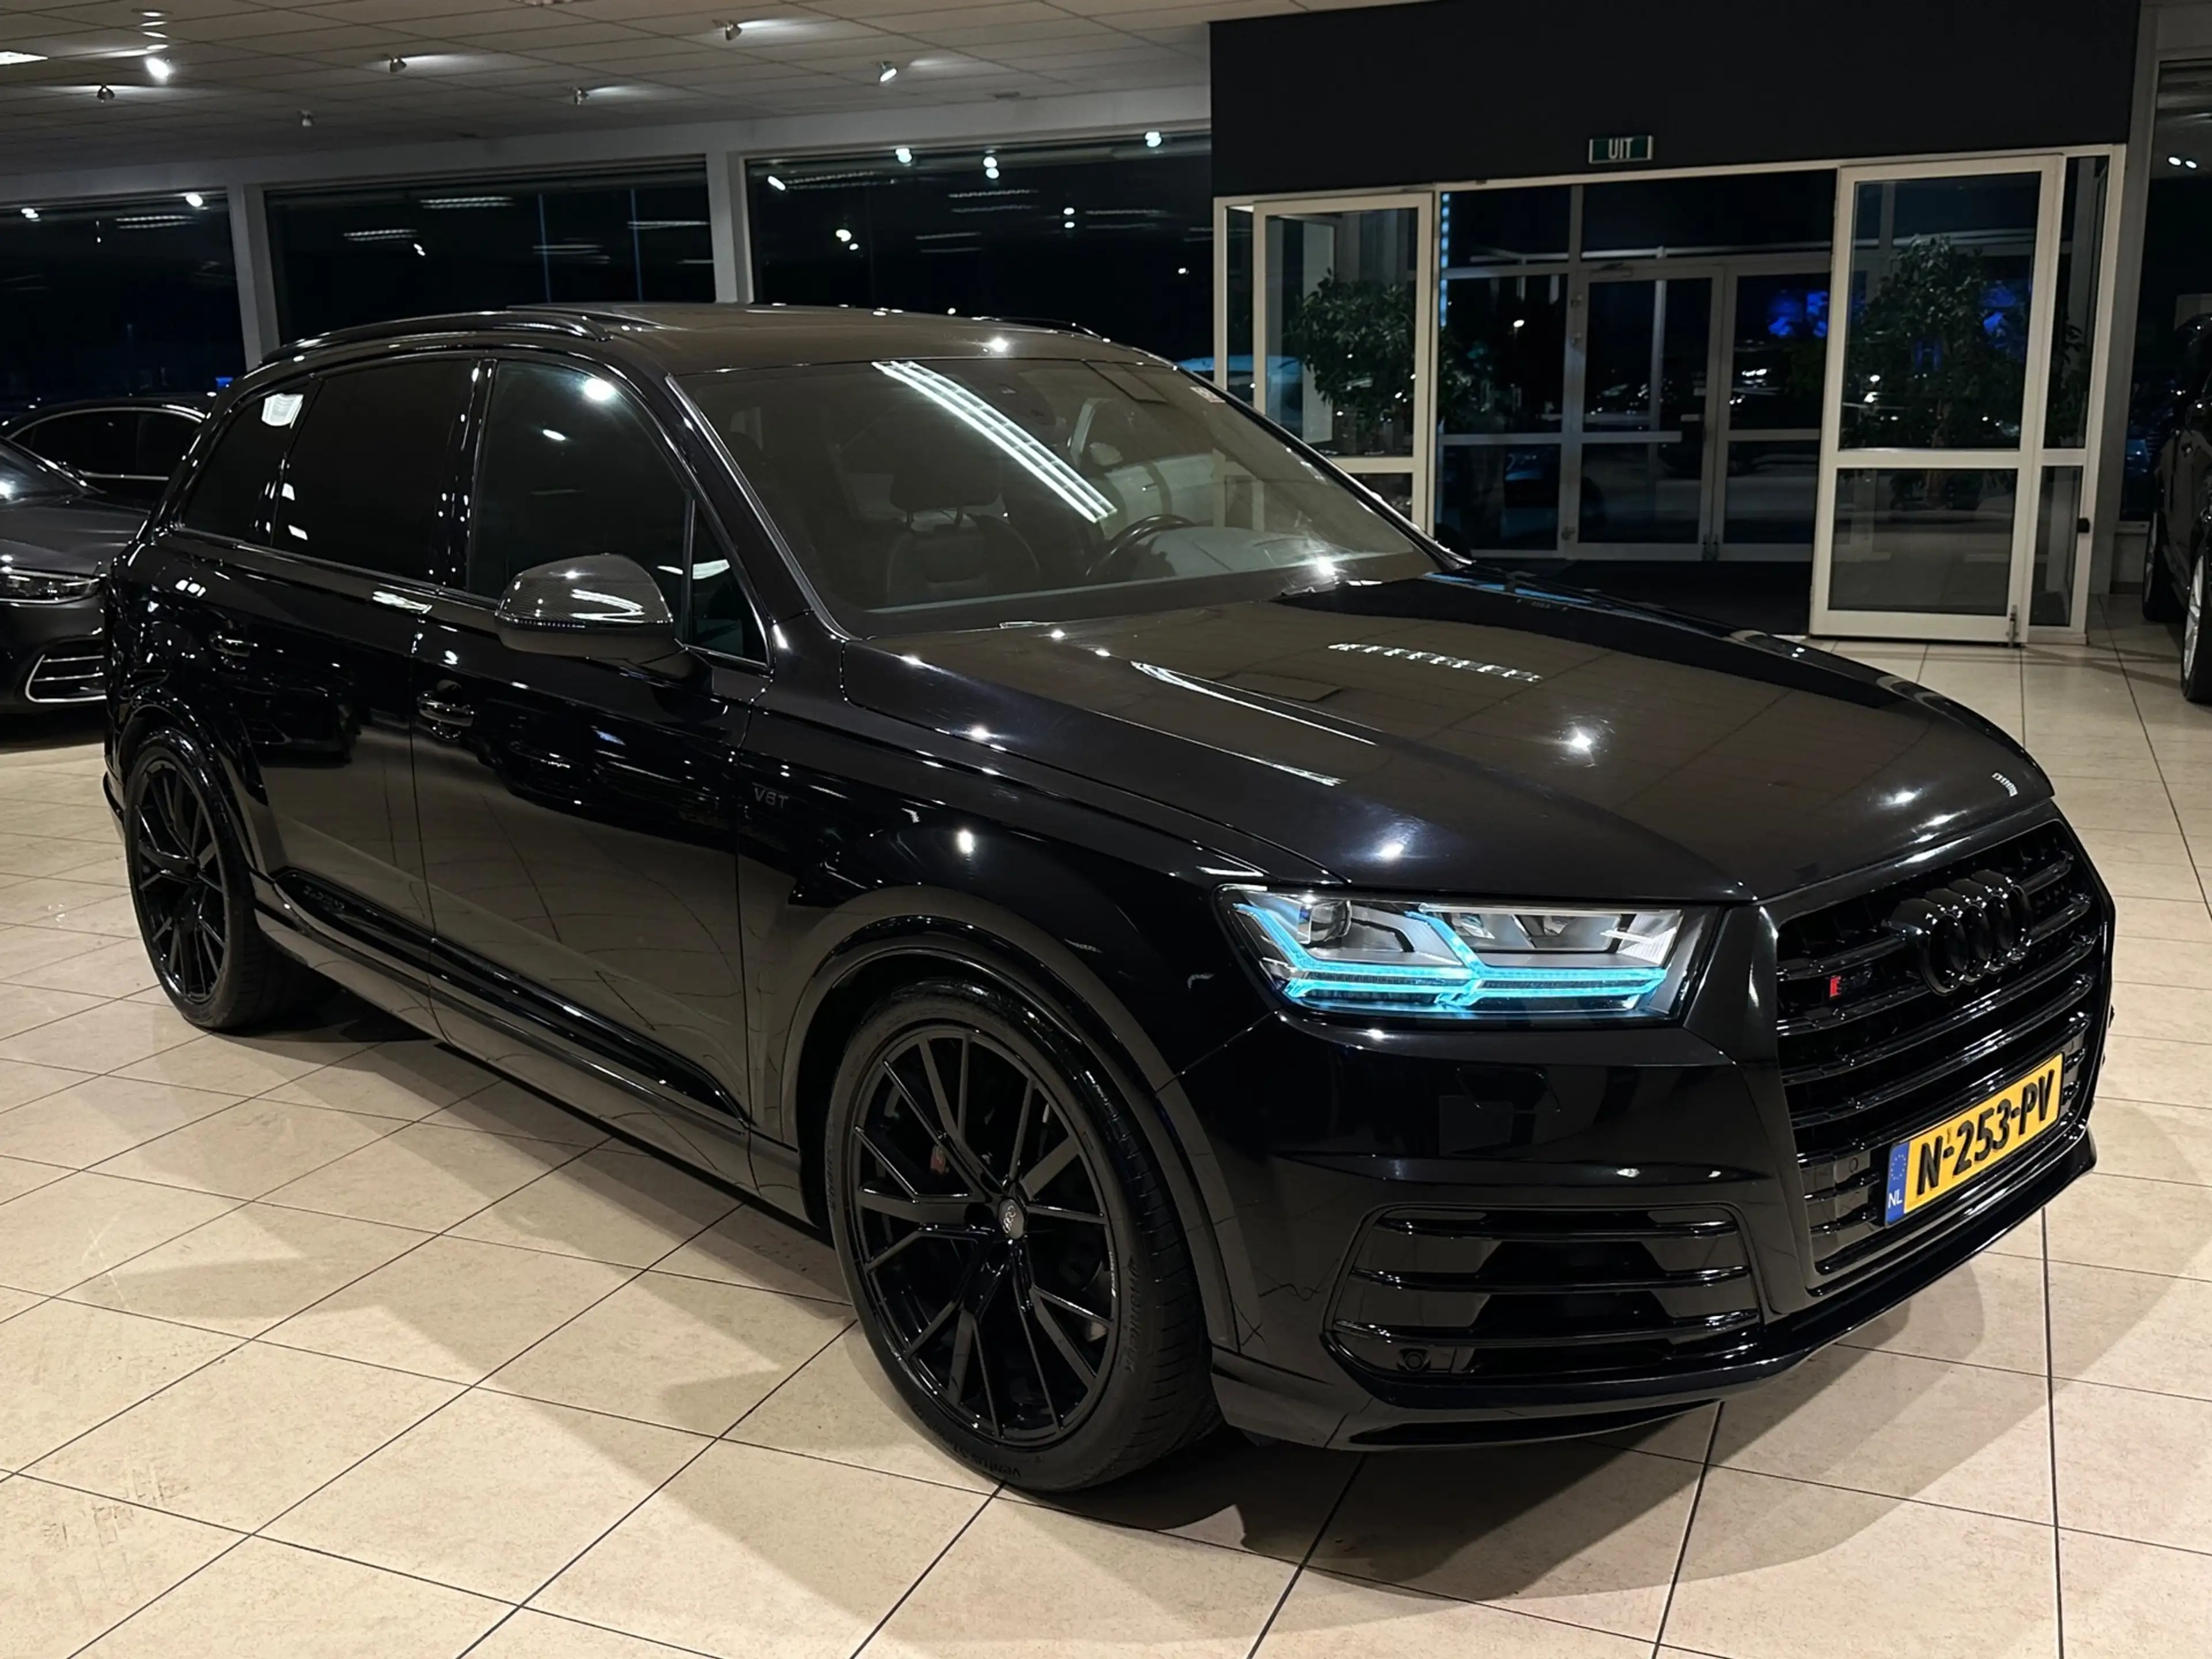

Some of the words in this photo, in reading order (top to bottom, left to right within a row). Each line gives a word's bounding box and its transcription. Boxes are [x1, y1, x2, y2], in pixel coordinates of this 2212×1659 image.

[1608, 138, 1633, 159] UIT
[754, 786, 789, 809] V8T
[1916, 1069, 2055, 1196] N-253-PV
[1888, 1189, 1903, 1209] NL
